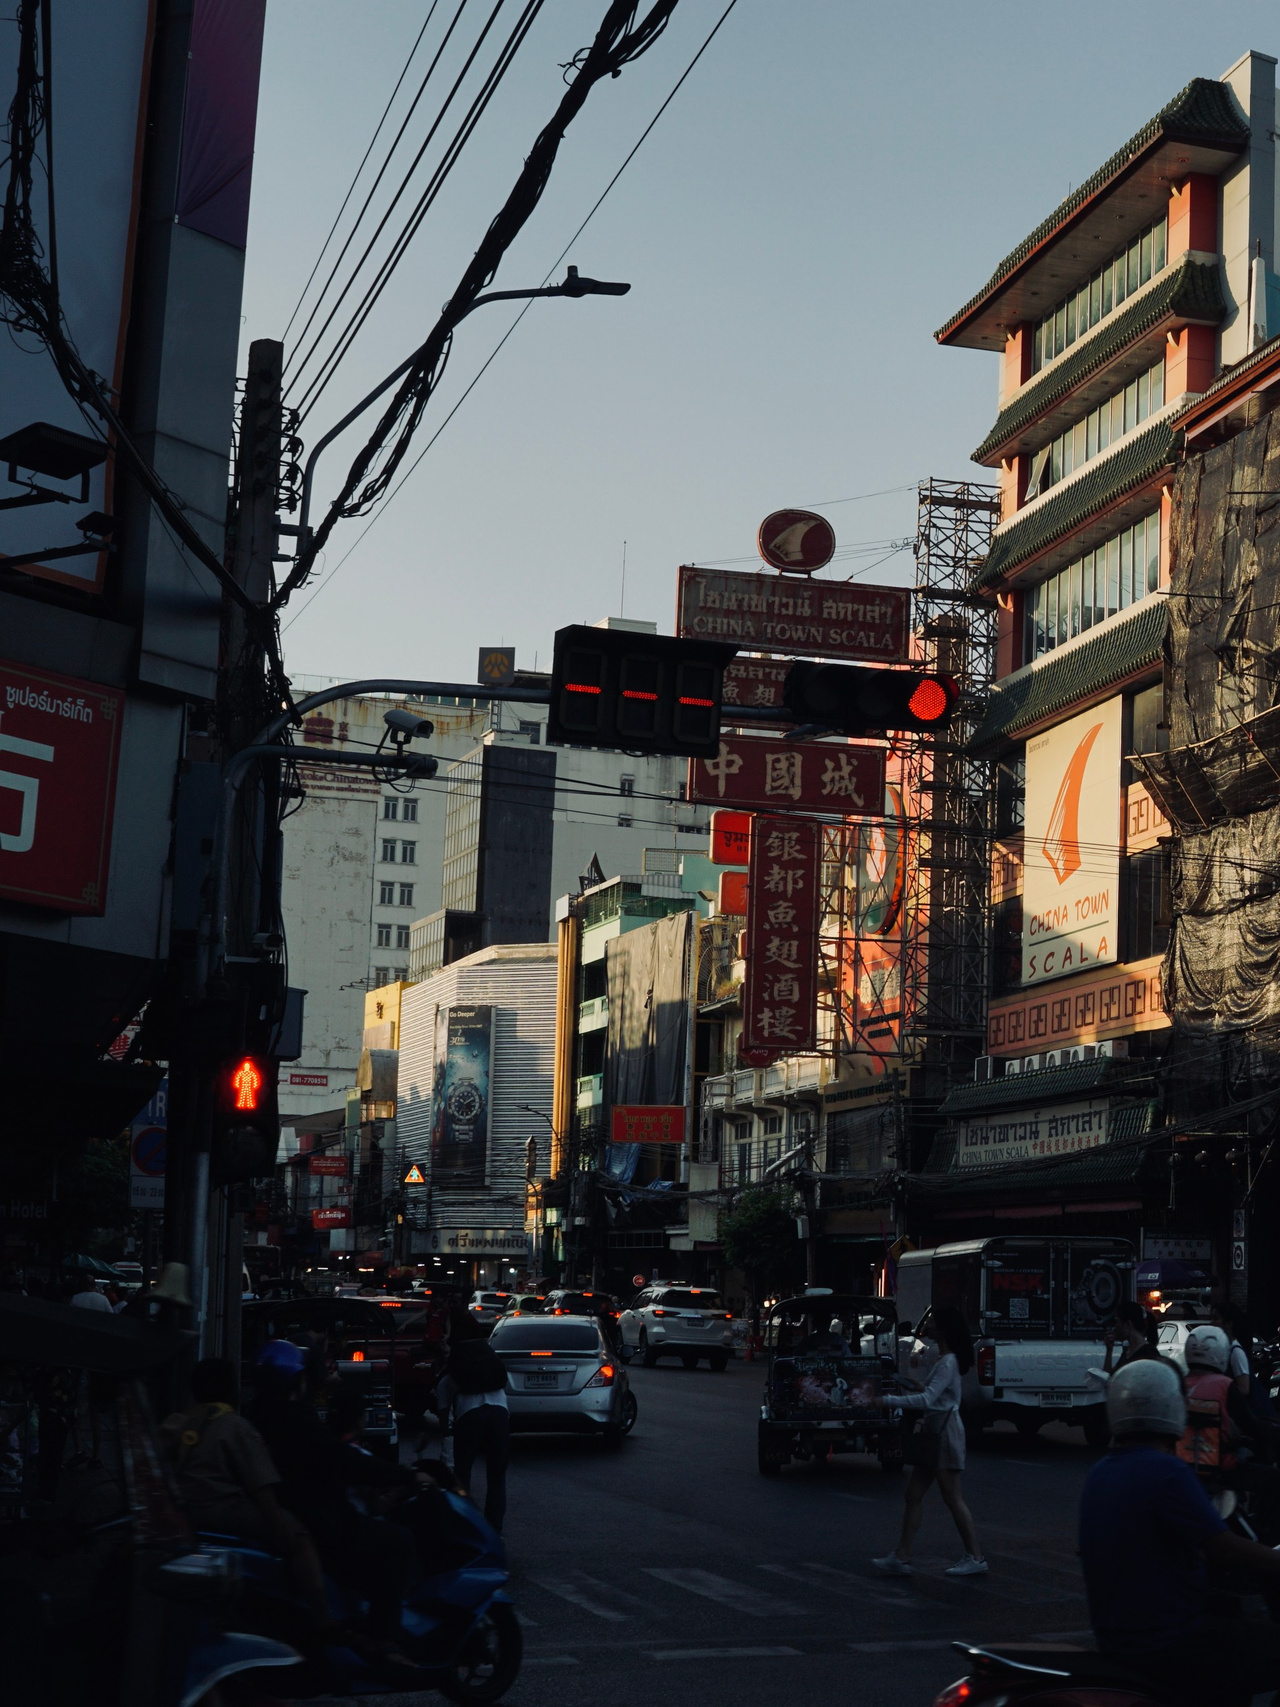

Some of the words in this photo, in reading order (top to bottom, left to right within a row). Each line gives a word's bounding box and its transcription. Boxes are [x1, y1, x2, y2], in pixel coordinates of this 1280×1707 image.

[693, 617, 755, 638] CHINA
[763, 621, 823, 644] TOWN
[828, 629, 895, 650] SCALA
[5, 685, 94, 724] ซูเปอร์มาร์เก็ต
[704, 741, 865, 808] 中國城
[1029, 905, 1069, 936] CHINA
[1075, 889, 1110, 921] TOWN
[756, 830, 808, 1041] 銀都魚翅酒樓
[1028, 936, 1108, 979] SCALA
[962, 1152, 982, 1164] CHINA
[983, 1149, 1004, 1162] TOWN
[1006, 1145, 1029, 1160] SCALA
[11, 1198, 47, 1219] Hotel
[993, 1273, 1042, 1290] NSK
